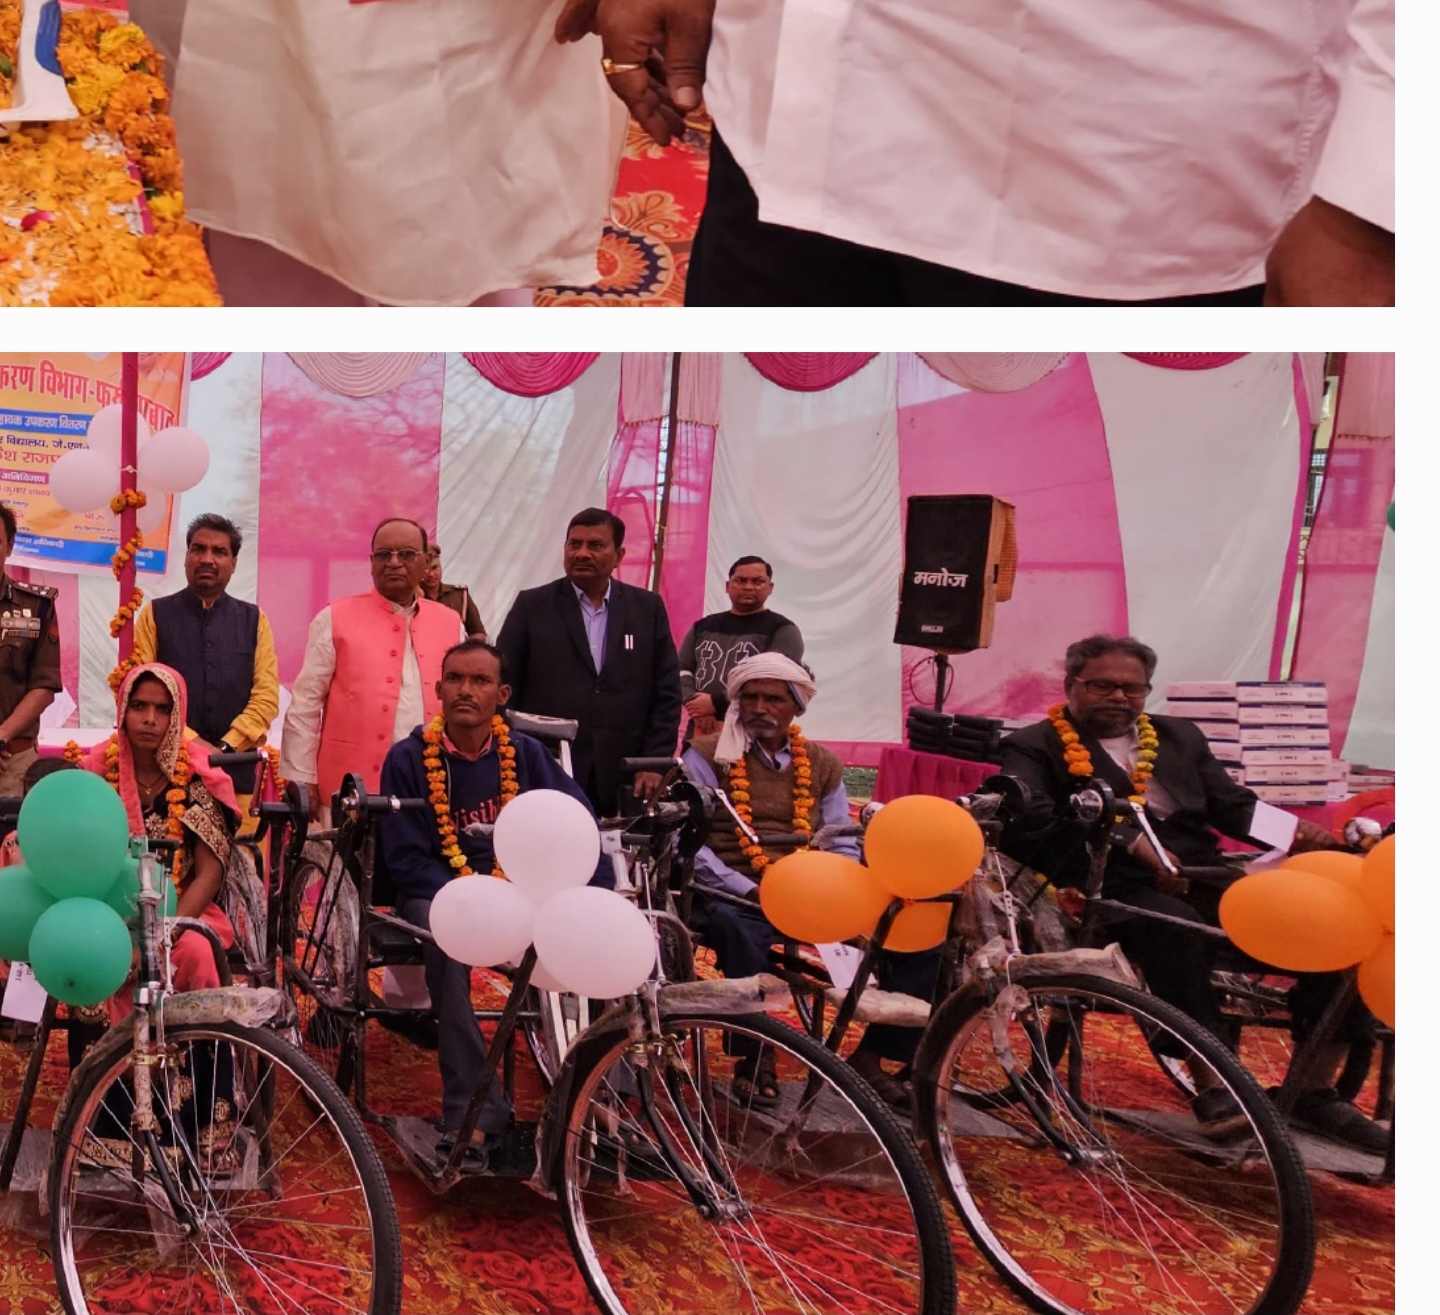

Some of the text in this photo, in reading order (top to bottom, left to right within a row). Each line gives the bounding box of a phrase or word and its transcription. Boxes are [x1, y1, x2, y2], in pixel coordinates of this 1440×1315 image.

[24, 415, 58, 429] उपकरण
[59, 414, 87, 431] वितरण
[22, 451, 62, 465] राजप
[913, 567, 969, 588] मनोज
